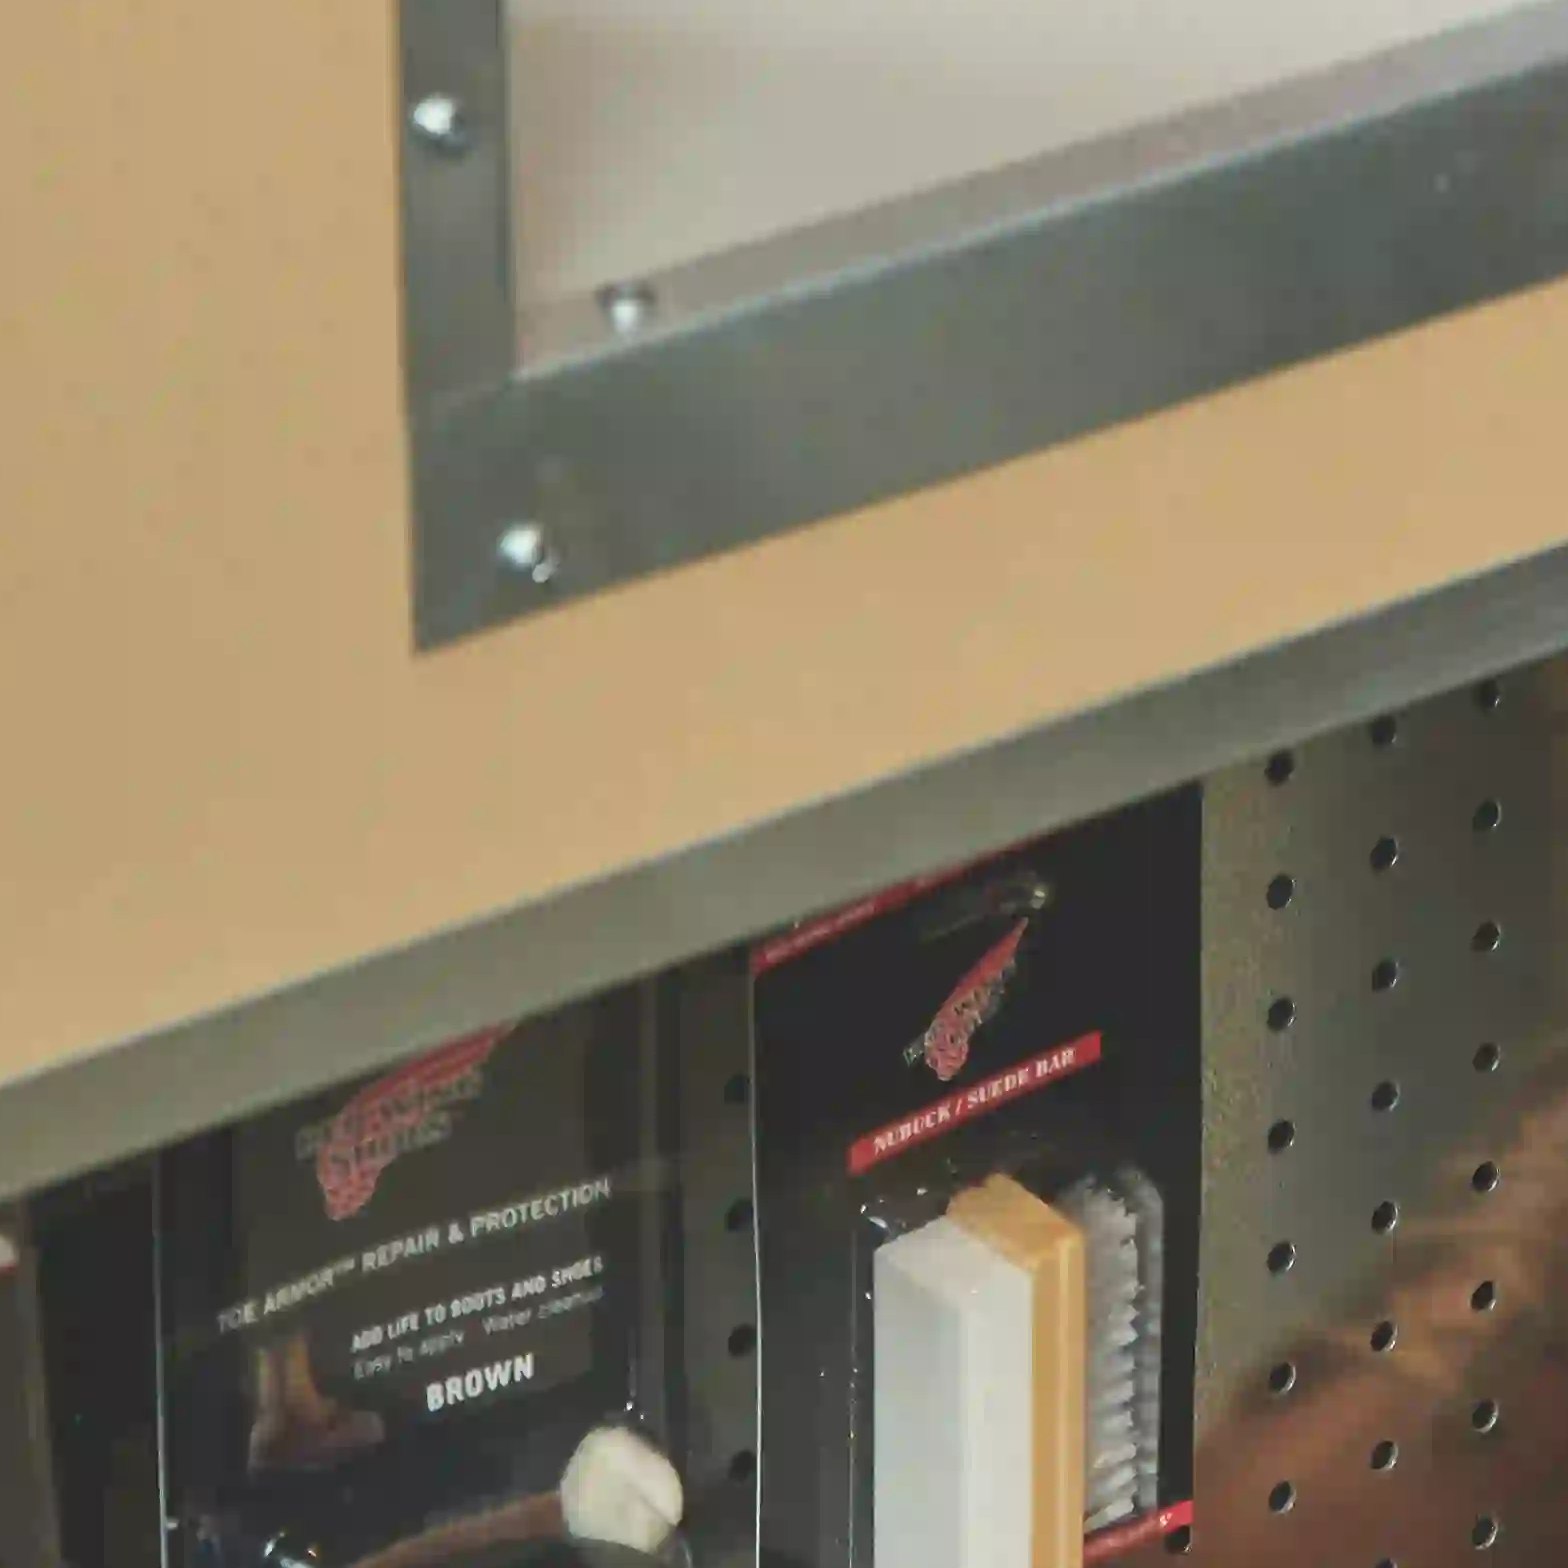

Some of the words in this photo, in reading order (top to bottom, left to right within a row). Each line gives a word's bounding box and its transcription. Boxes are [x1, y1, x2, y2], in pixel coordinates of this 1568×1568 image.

[872, 1102, 951, 1156] NUBUCK
[965, 1066, 1029, 1110] SUEDE
[1033, 1045, 1076, 1078] BAR
[361, 1226, 441, 1273] REPAIR
[447, 1222, 464, 1244] &
[468, 1177, 612, 1238] PROTECTION
[387, 1311, 420, 1341] LIFE
[424, 1303, 447, 1325] TO
[511, 1274, 546, 1300] AND
[425, 1352, 534, 1413] BROWN
